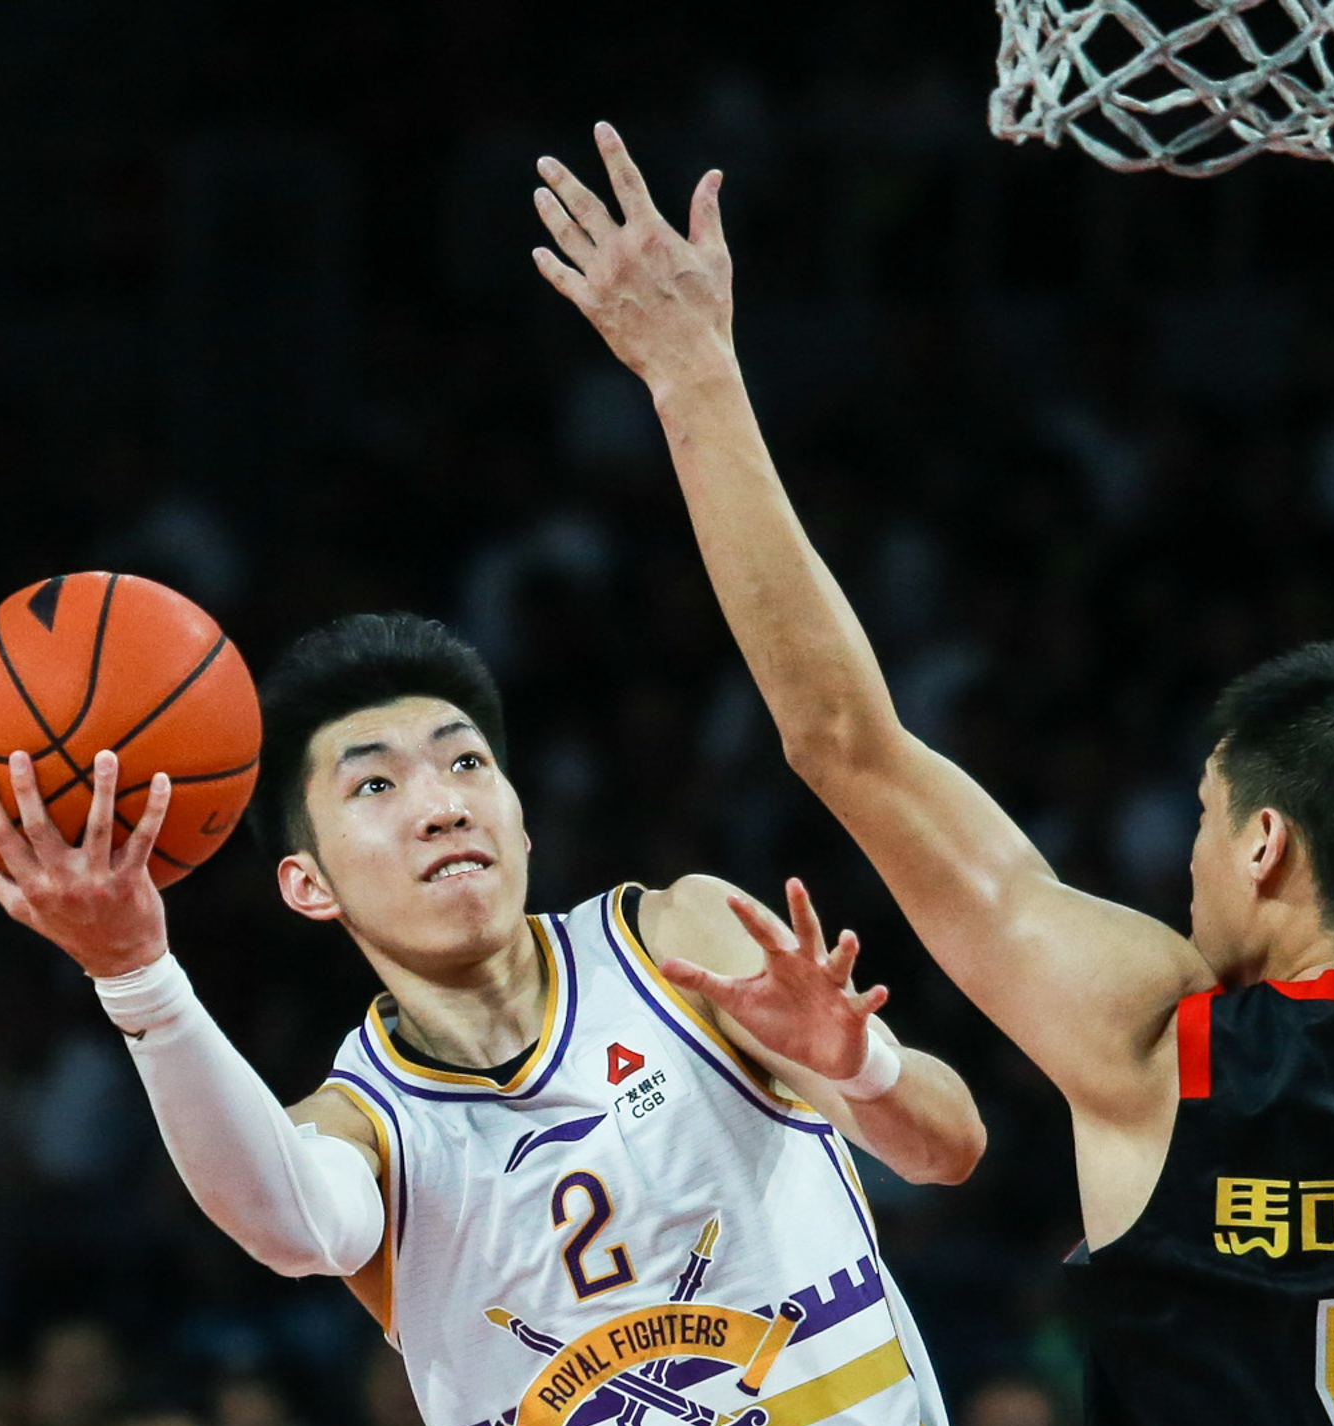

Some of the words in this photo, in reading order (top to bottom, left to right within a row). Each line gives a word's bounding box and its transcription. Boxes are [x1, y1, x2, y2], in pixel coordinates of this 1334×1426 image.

[614, 1069, 666, 1113] 广发银行
[632, 1091, 665, 1119] CGB
[551, 1169, 636, 1301] 2
[538, 1344, 610, 1412] ROYAL
[607, 1314, 728, 1359] FIGHTERS
